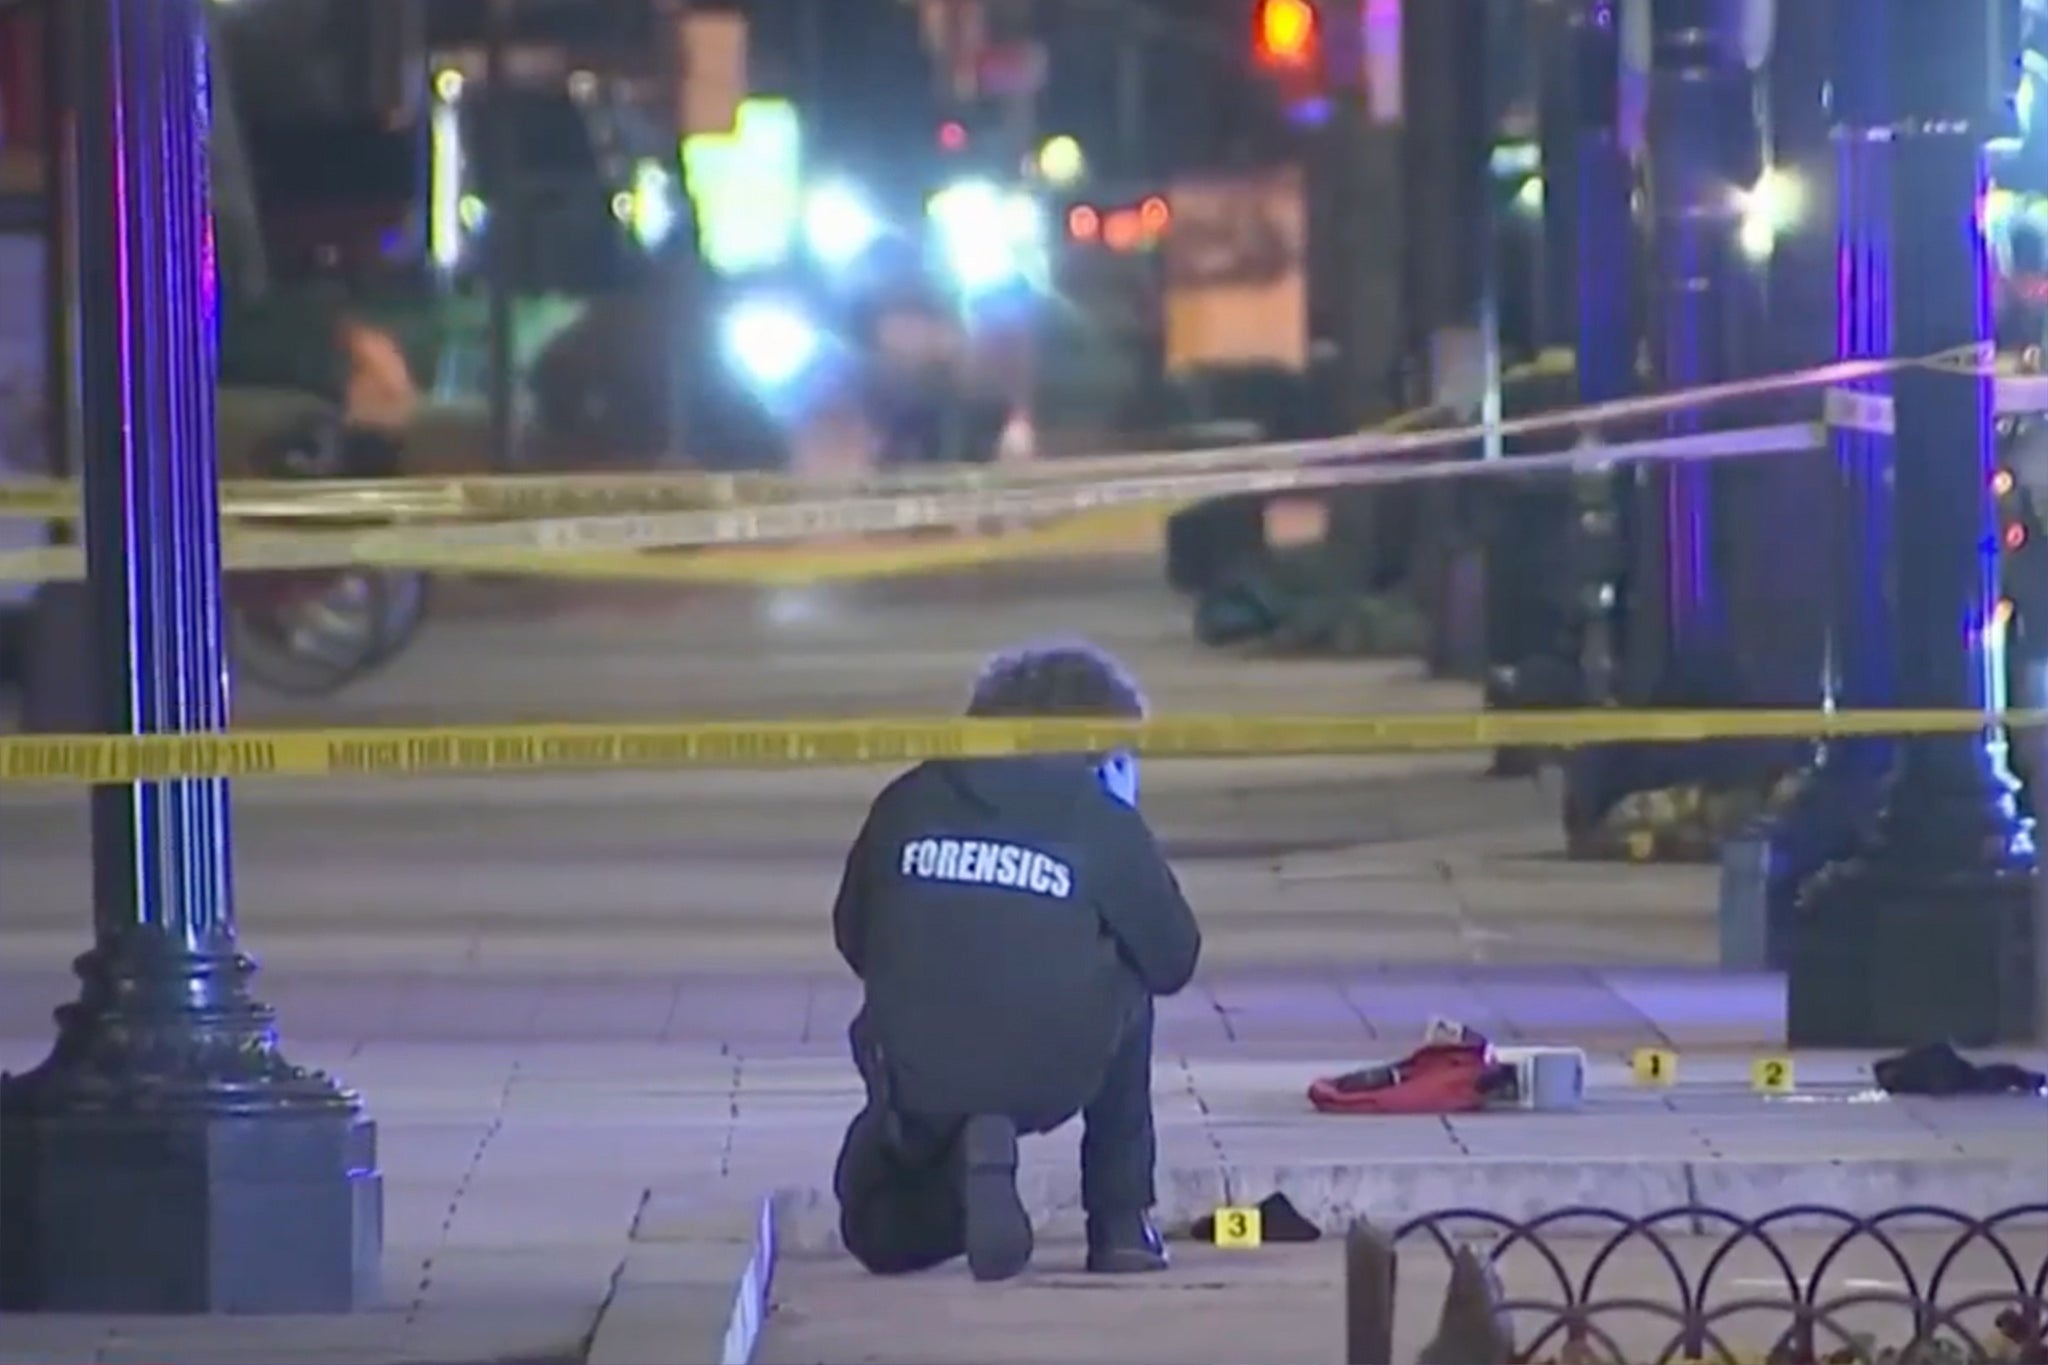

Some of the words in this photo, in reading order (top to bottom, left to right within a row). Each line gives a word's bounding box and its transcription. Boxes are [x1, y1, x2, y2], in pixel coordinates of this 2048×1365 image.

[902, 838, 1072, 898] FORENSICS
[1650, 1053, 1661, 1078] 1
[1765, 1061, 1784, 1086] 2
[1228, 1212, 1248, 1238] 3
